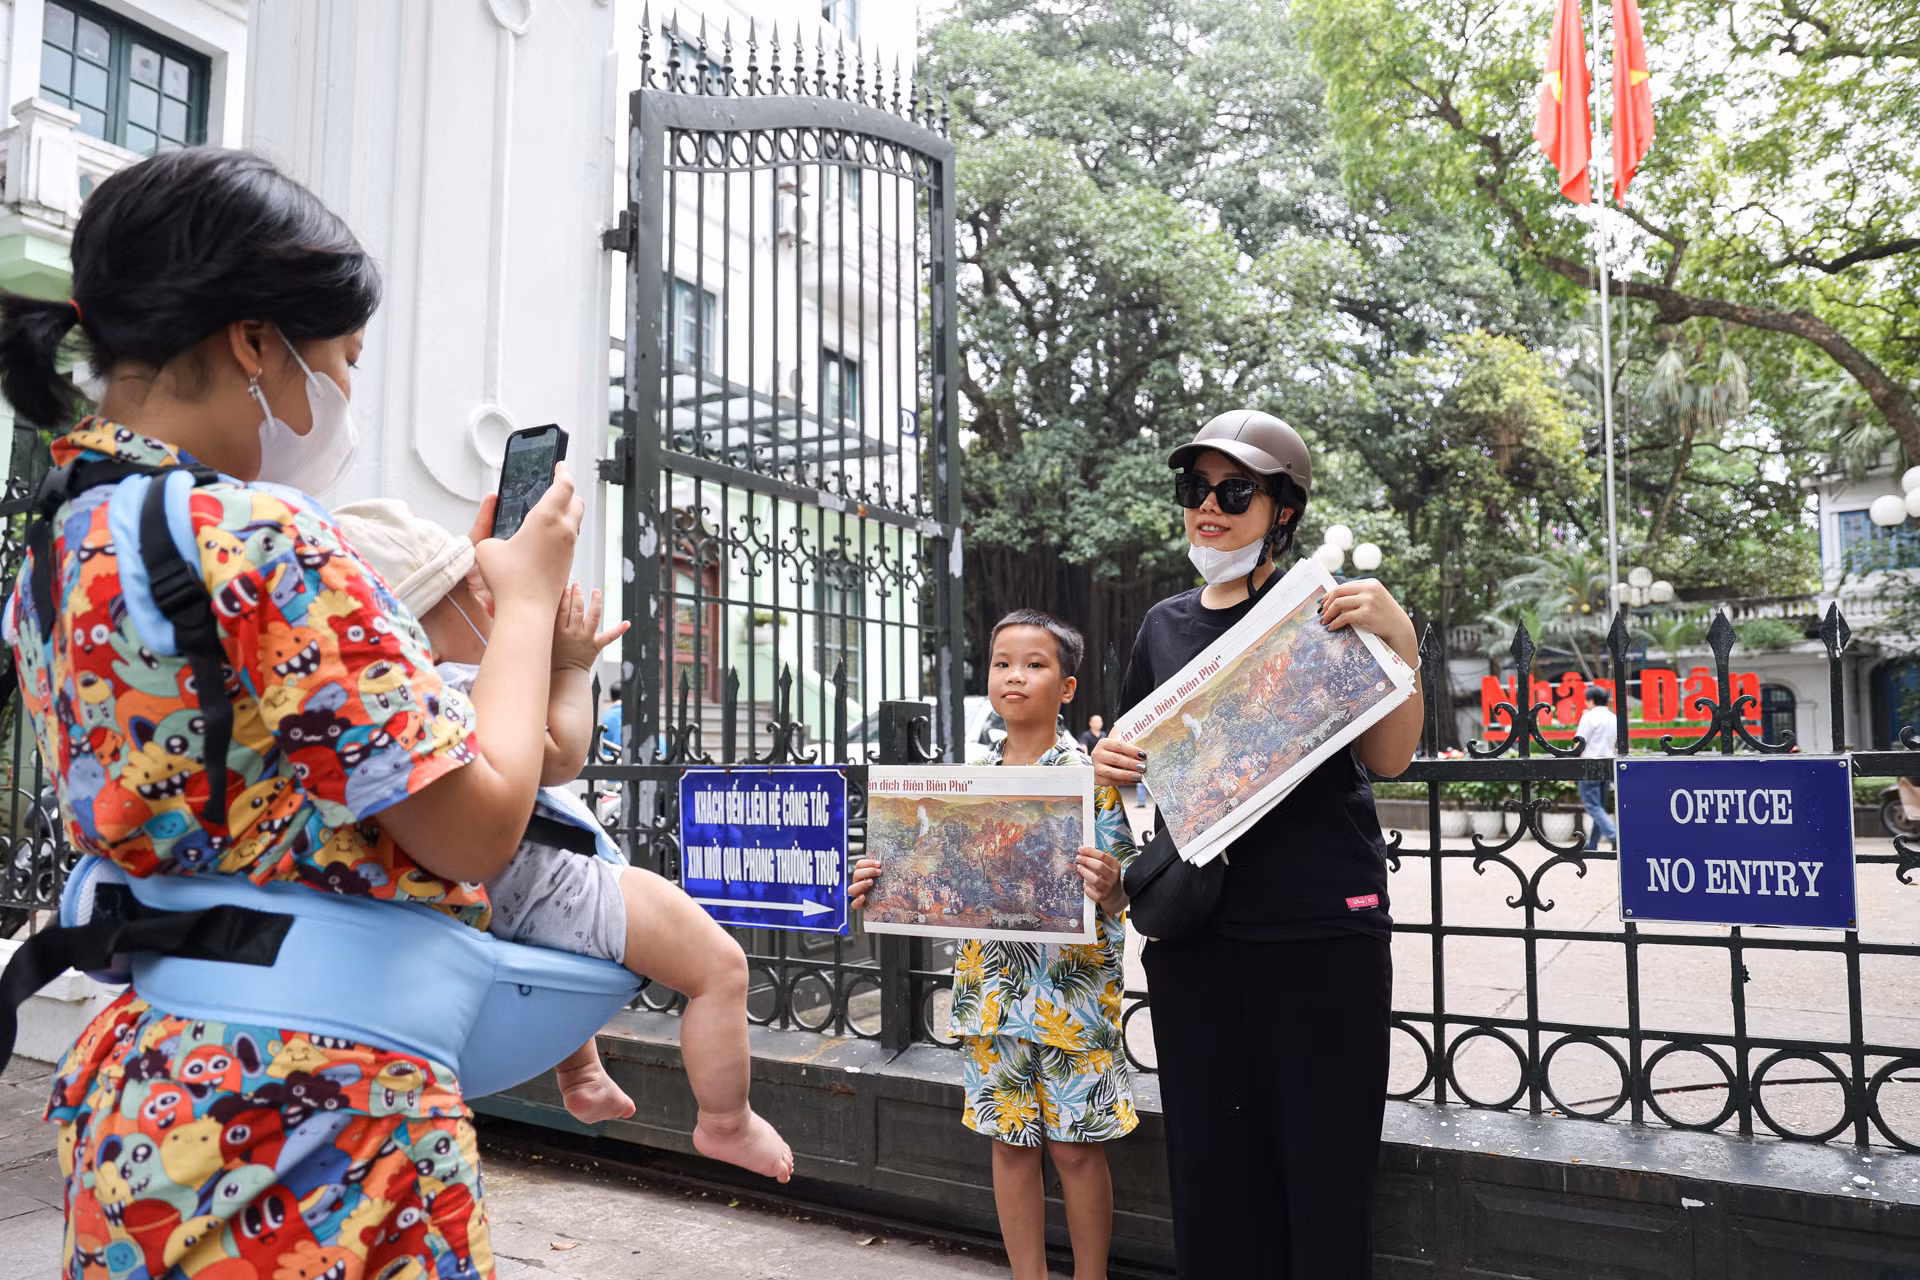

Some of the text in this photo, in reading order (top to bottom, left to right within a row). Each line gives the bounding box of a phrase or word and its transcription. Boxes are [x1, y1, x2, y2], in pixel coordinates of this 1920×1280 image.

[1133, 713, 1155, 735] dịch
[1154, 695, 1178, 716] Điện
[1176, 677, 1200, 698] Biên
[1640, 666, 1762, 722] Dân
[694, 779, 830, 831] KHÁCH ĐẾN LIÊN HỆ CÔNG TÁC
[879, 779, 900, 793] dịch
[902, 779, 924, 793] Điện
[926, 779, 947, 792] Biên
[1670, 788, 1793, 825] OFFICE
[687, 838, 840, 894] XIN MỜI QUA PHÒNG THƯỜNG TRỰC
[1646, 857, 1824, 897] NO ENTRY
